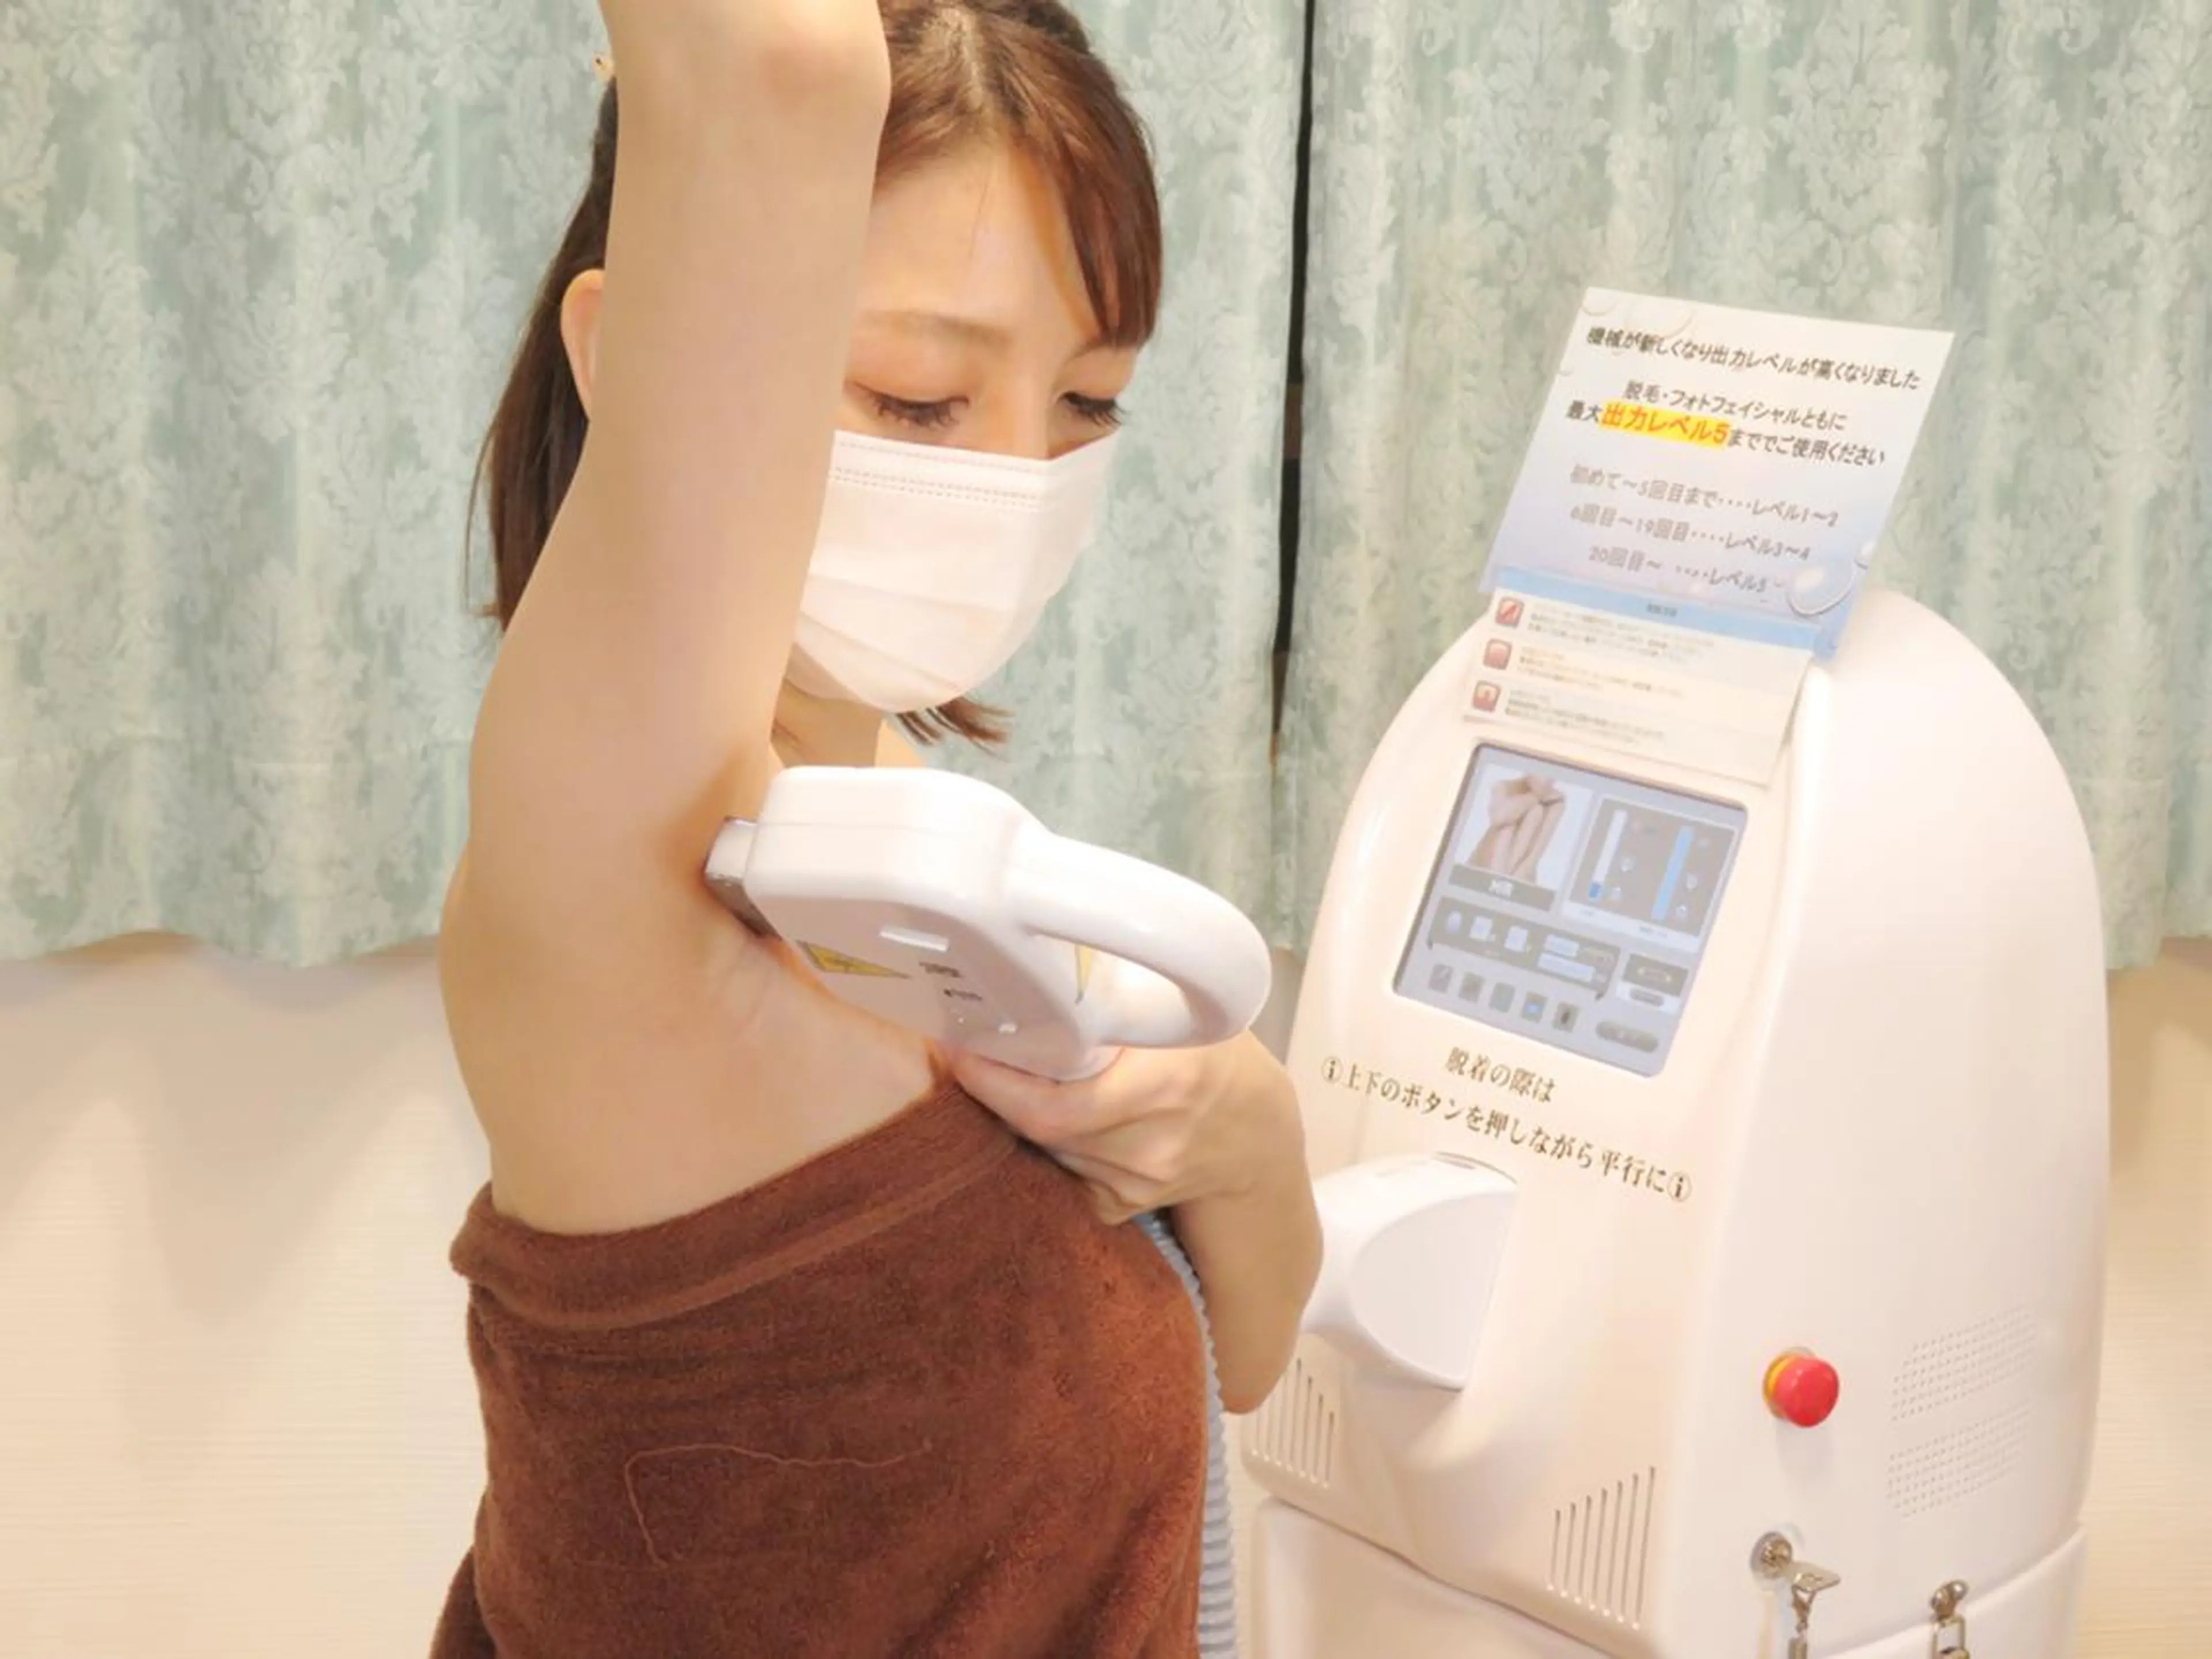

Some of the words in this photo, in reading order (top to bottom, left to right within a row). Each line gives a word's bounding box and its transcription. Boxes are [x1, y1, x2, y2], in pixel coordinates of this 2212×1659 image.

[1586, 326, 1921, 390] 機械が新しくなり出力レベルが高くなりました
[1445, 1046, 1556, 1103] 脱着の際は
